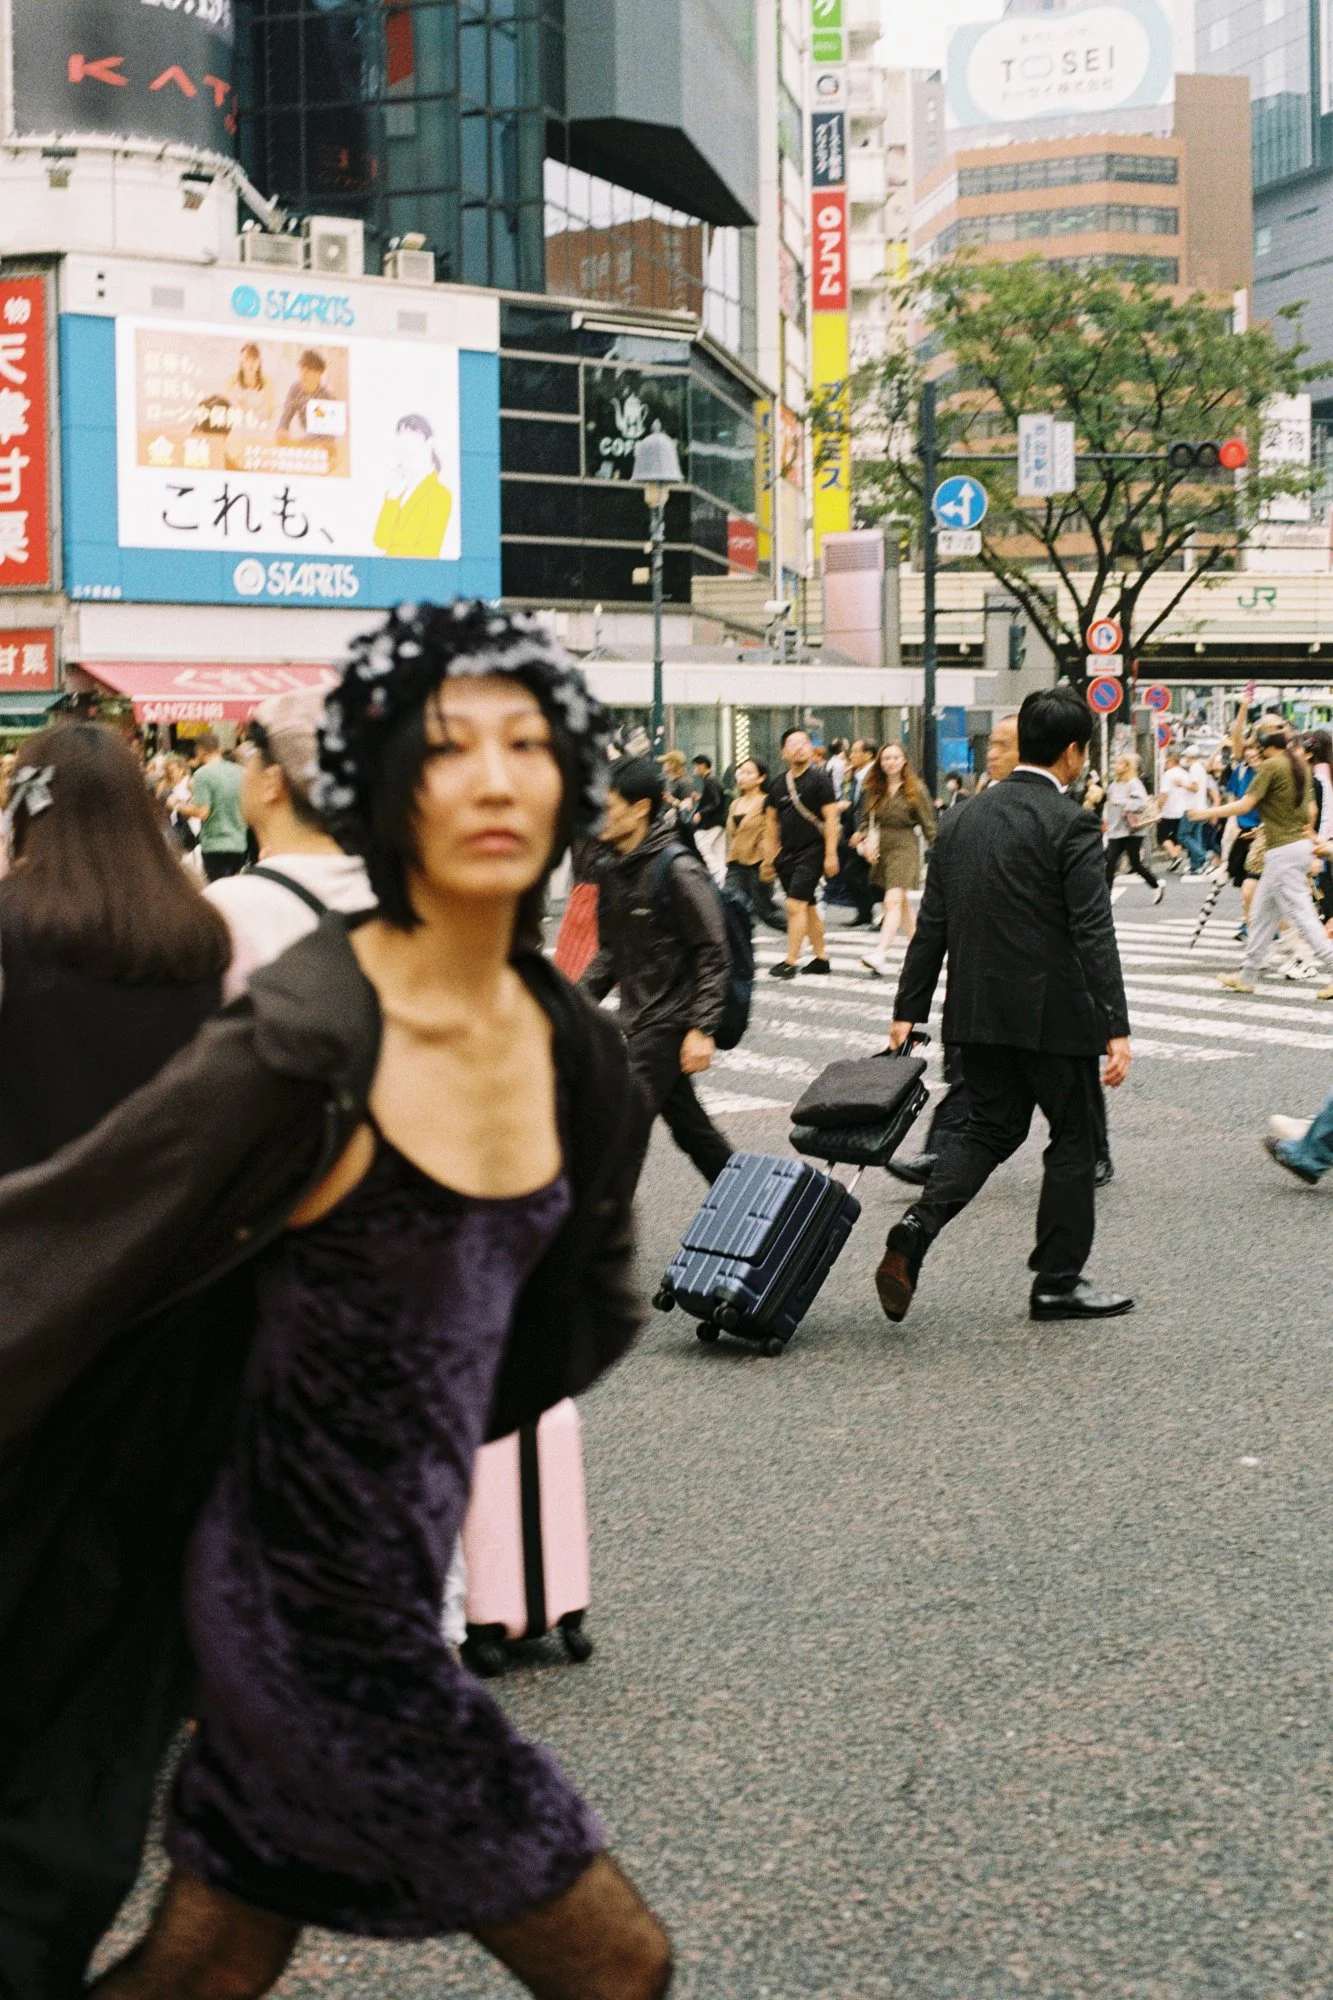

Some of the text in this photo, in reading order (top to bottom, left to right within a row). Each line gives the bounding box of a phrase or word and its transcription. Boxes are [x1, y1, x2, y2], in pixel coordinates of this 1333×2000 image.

[1001, 45, 1115, 82] TOSEI
[162, 483, 334, 544] これも、
[266, 560, 359, 598] STARTS
[1237, 586, 1277, 610] JR
